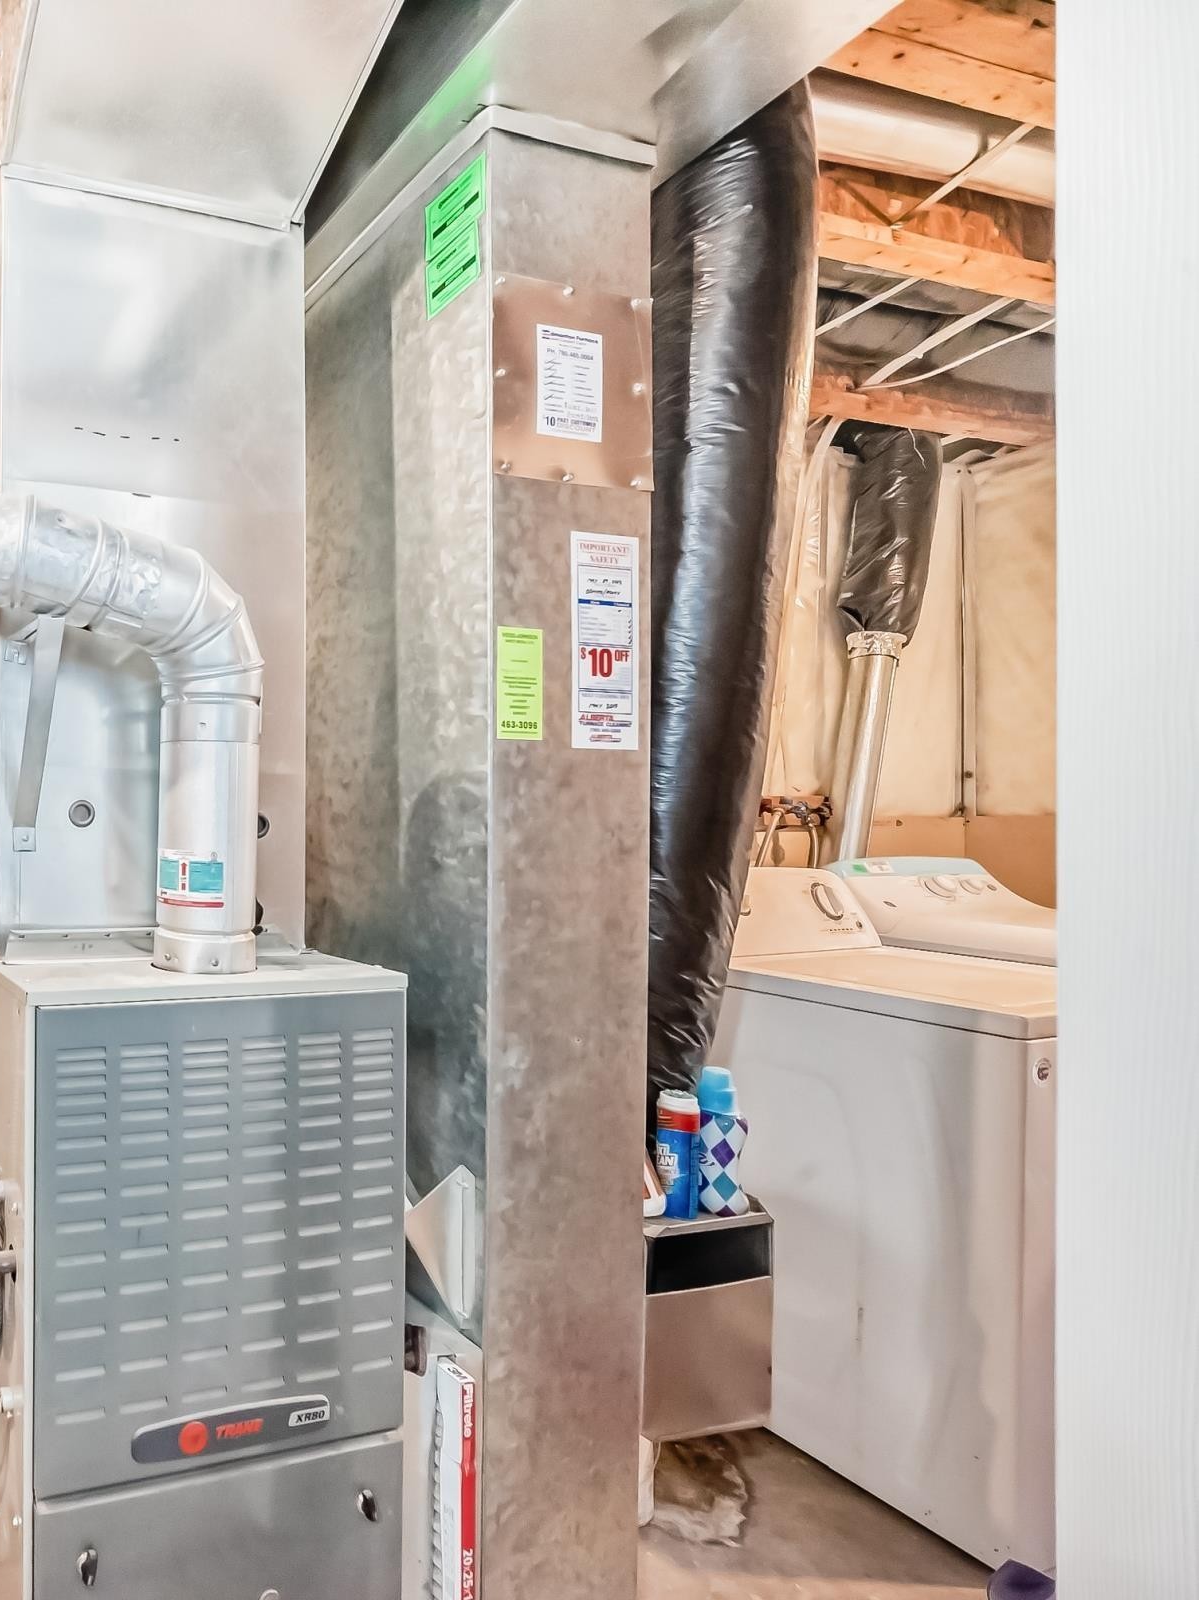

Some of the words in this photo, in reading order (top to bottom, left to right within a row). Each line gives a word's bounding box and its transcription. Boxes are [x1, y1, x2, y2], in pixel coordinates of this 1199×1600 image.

[545, 416, 556, 427] 10
[588, 647, 613, 678] 10
[614, 649, 631, 663] OFF
[215, 1417, 265, 1440] TRANE
[295, 1409, 326, 1424] XR80
